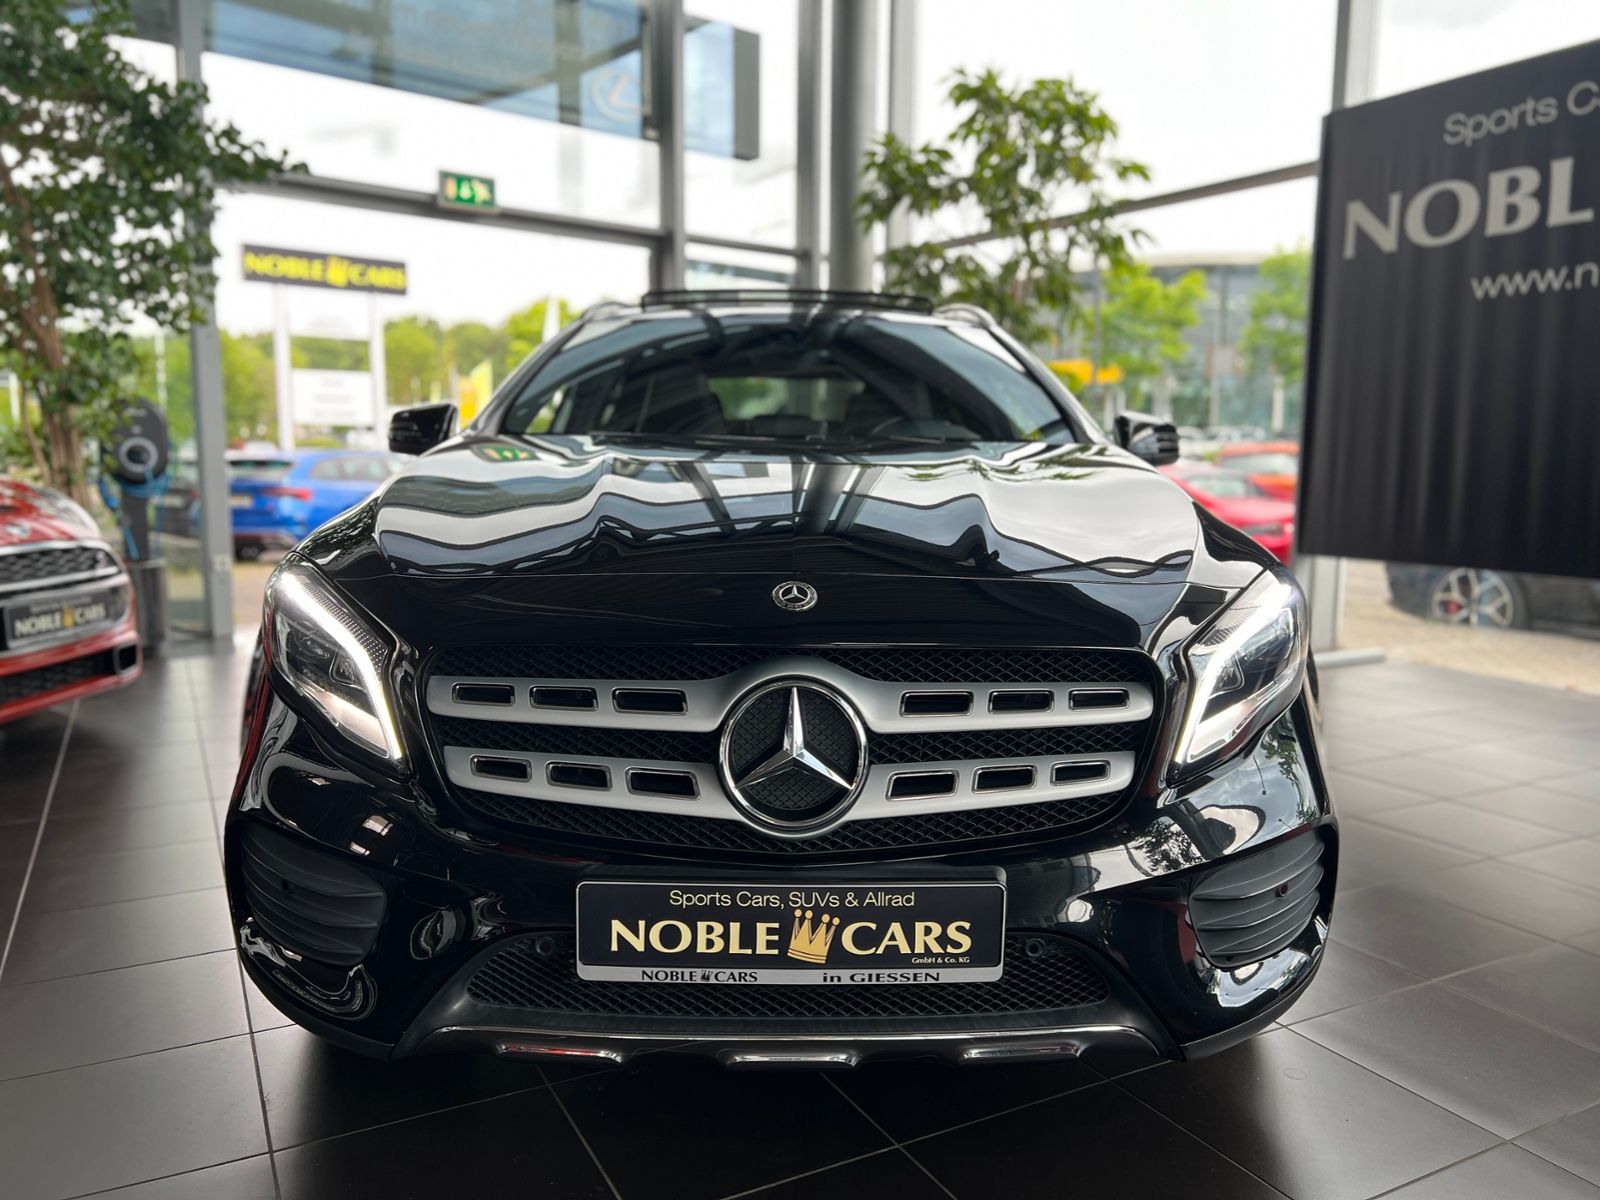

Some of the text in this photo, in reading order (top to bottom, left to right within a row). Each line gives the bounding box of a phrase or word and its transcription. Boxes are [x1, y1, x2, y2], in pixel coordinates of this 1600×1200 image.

[1443, 80, 1600, 147] Sports C
[1343, 156, 1595, 261] NOBL
[244, 252, 405, 290] NOBLE CARS
[669, 889, 915, 909] Sports Cars, SUVs & Allrad
[610, 919, 972, 956] NOBLE CARS
[958, 956, 970, 964] KG
[641, 970, 758, 983] NOBLE CARS
[822, 972, 940, 983] in GIESSEN
